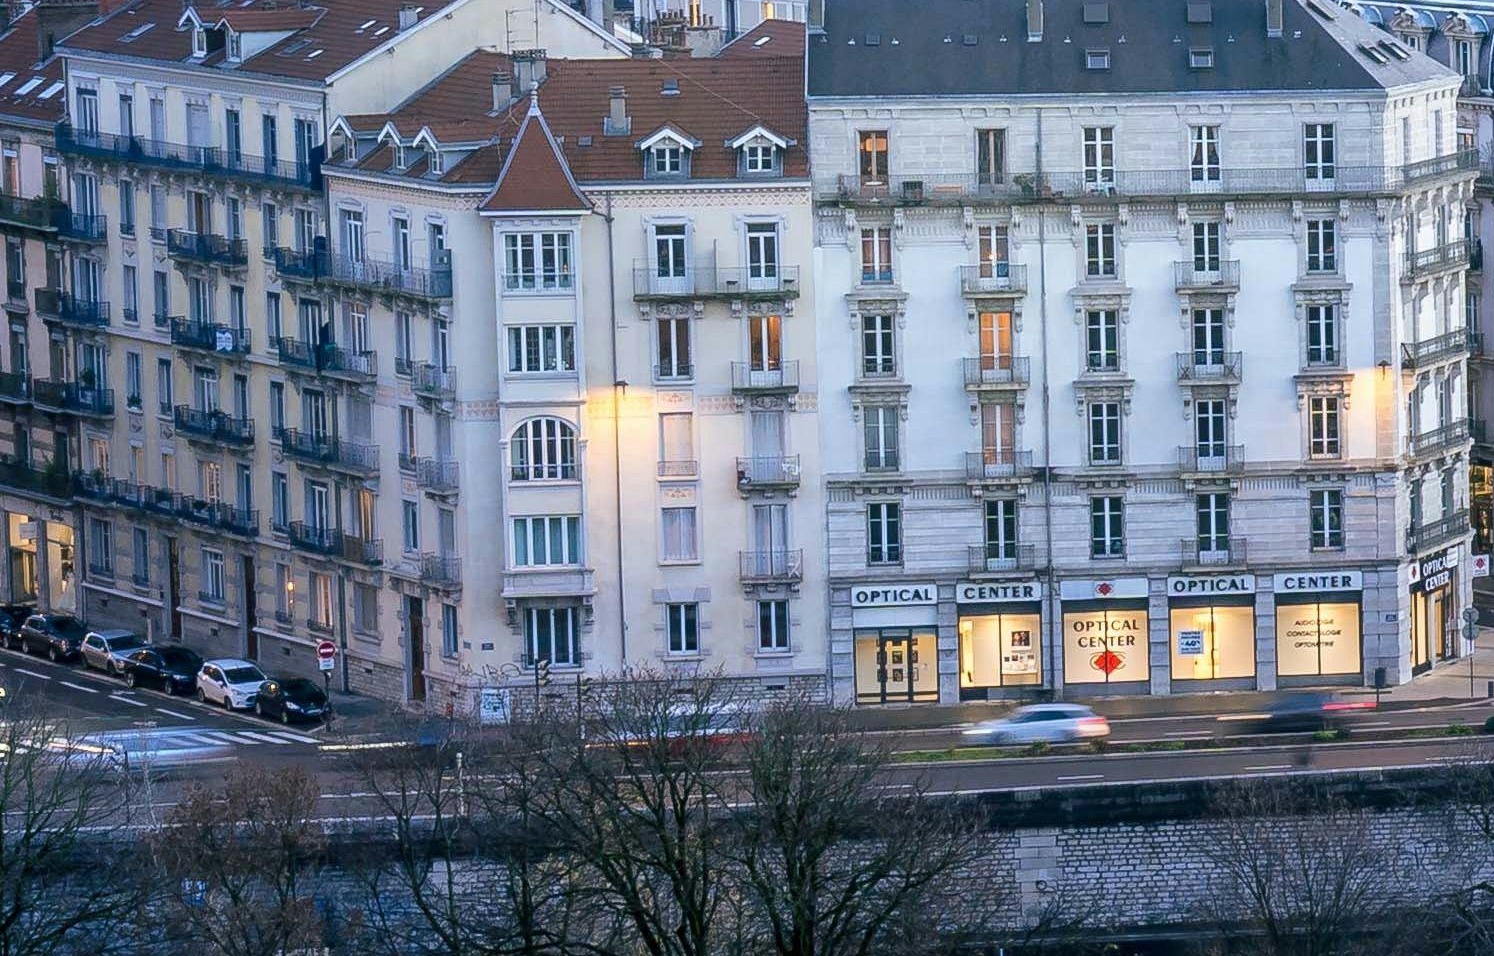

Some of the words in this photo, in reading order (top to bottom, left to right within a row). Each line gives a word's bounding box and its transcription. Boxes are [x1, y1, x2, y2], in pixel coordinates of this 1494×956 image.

[1422, 556, 1448, 576] OPTICA
[1173, 578, 1249, 592] OPTICAL
[1284, 575, 1352, 590] CENTER
[1425, 570, 1450, 591] CENTER
[856, 588, 932, 603] OPTICAL
[963, 585, 1034, 599] CENTER
[1073, 619, 1140, 632] OPTICAL
[1294, 618, 1334, 626] AUDIOOGIE
[1286, 629, 1342, 637] CONTACTLOGIE
[1078, 635, 1135, 648] CENTER
